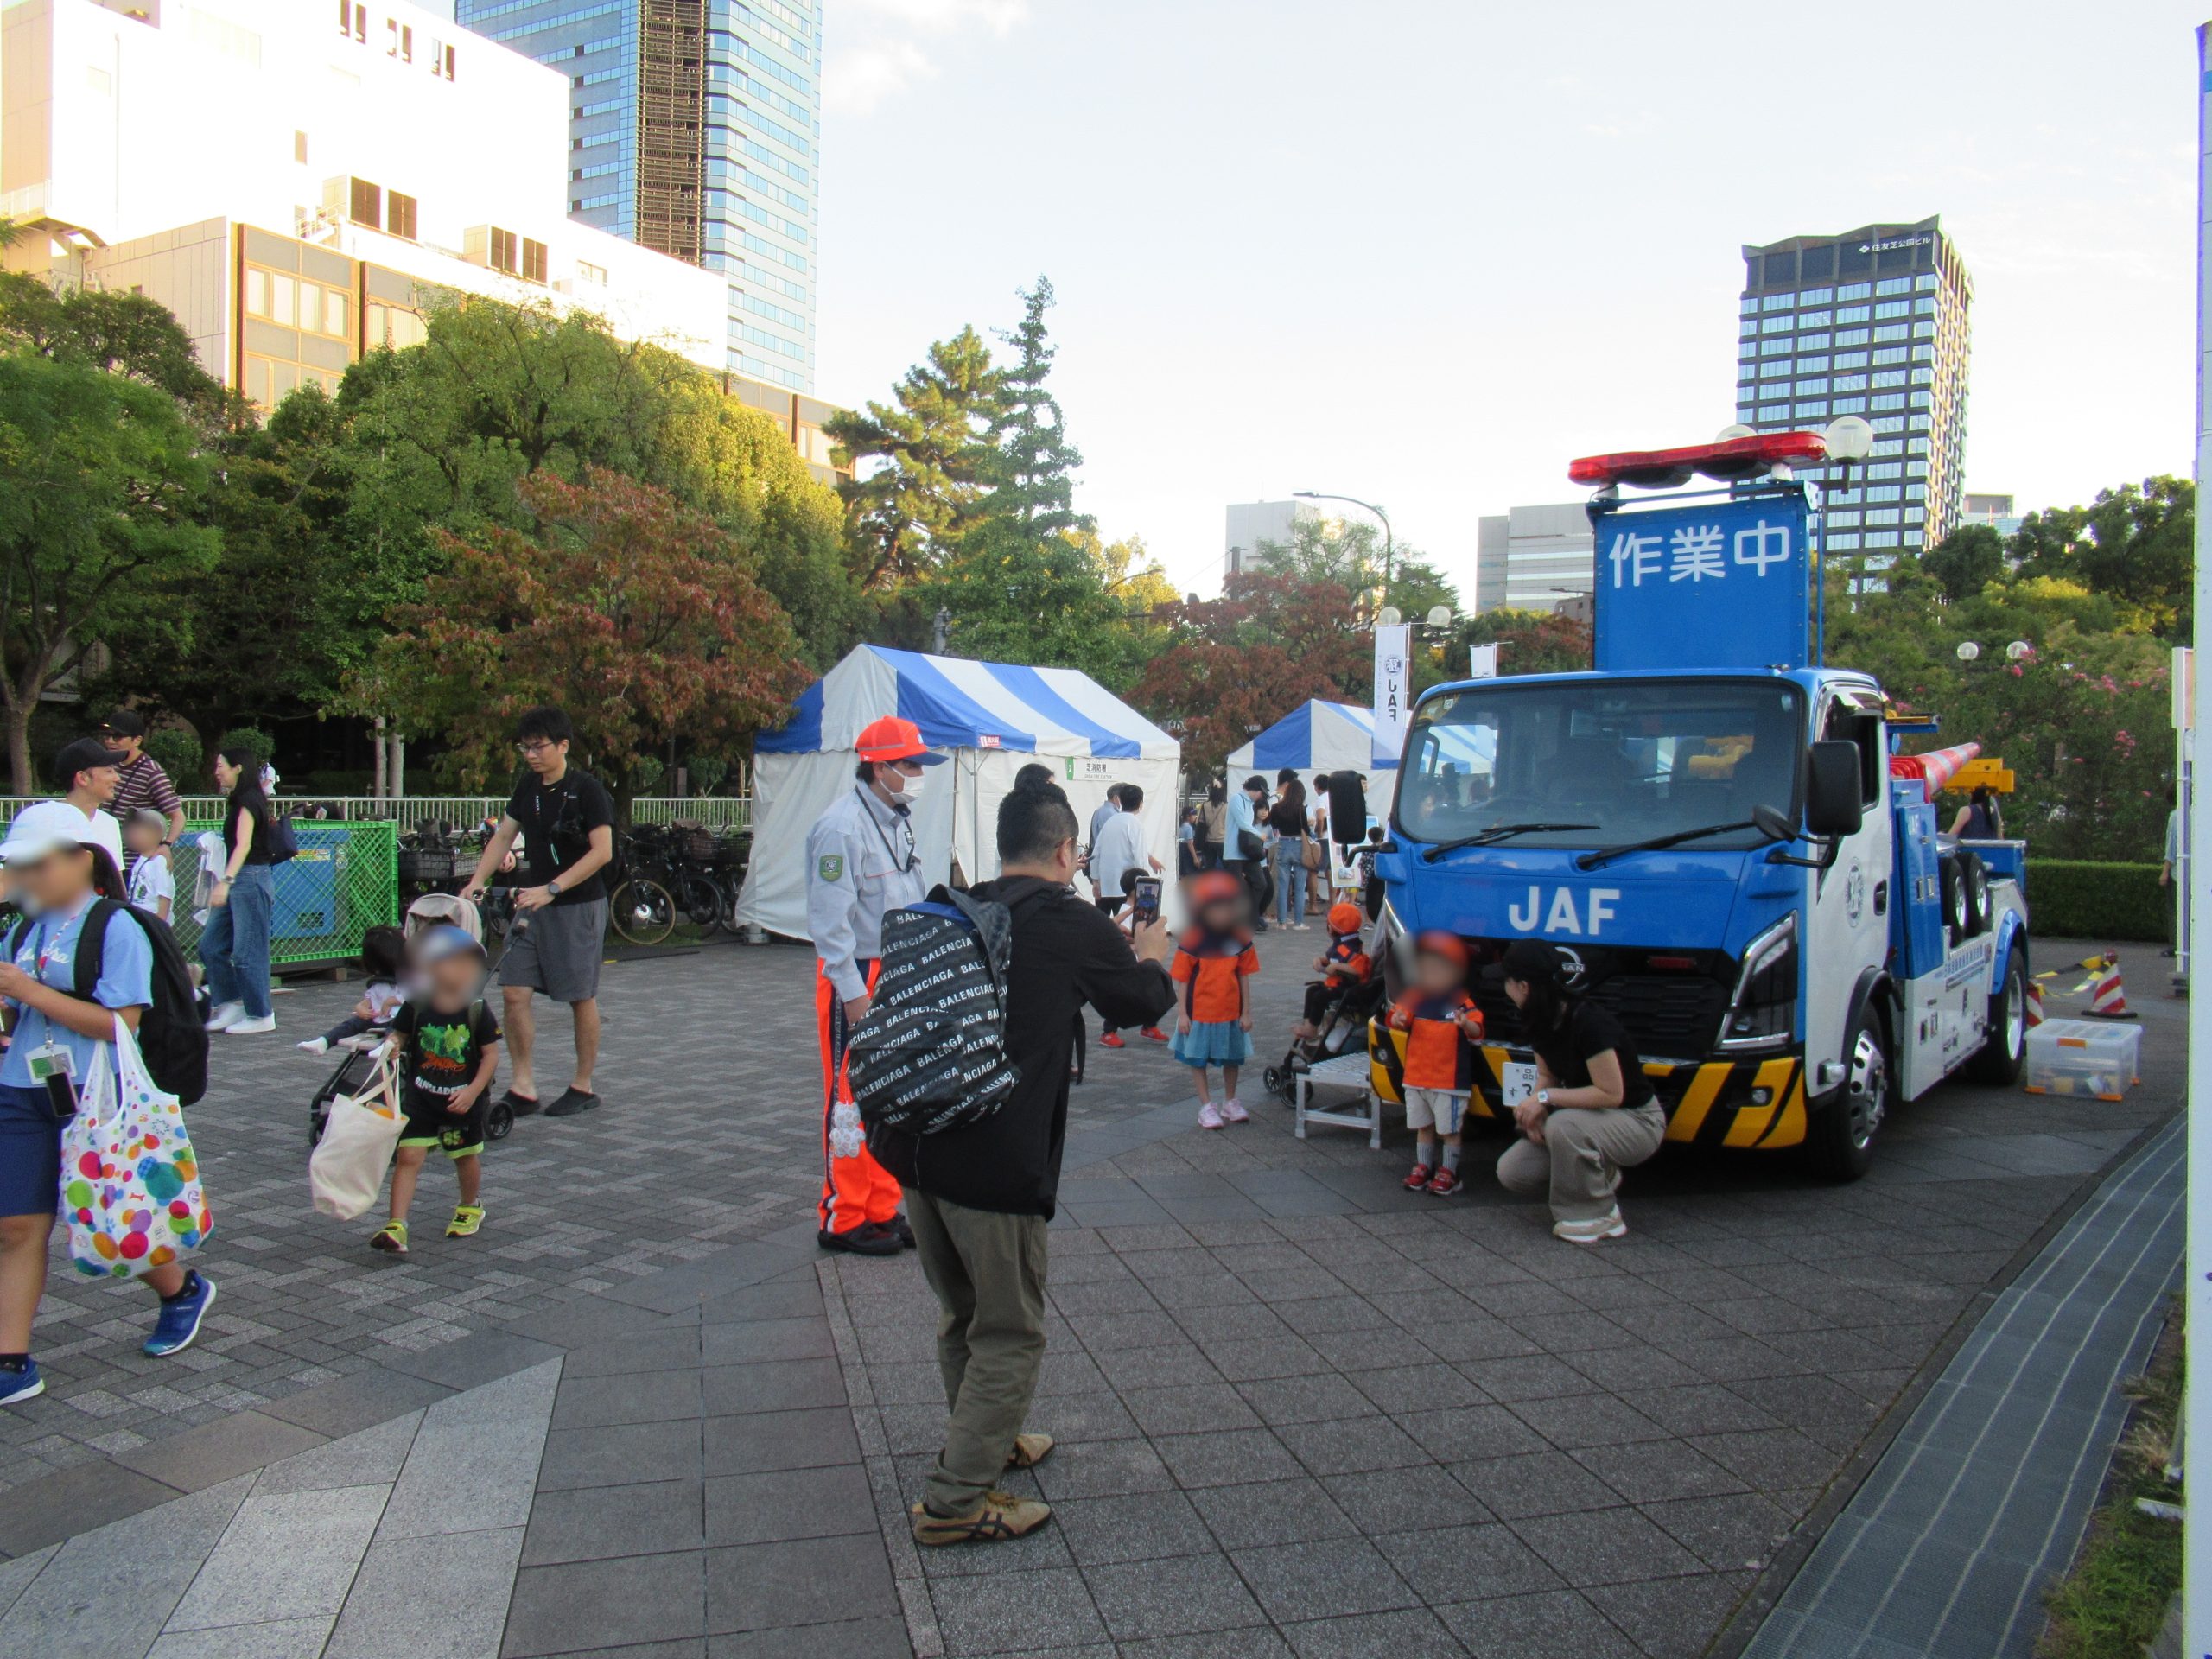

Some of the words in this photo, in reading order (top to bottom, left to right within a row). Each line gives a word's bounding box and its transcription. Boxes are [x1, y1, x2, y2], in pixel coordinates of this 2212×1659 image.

[1609, 519, 1790, 588] 作業中
[1508, 886, 1621, 936] JAF
[890, 969, 955, 1006] BALENCIAGA
[856, 1065, 912, 1101] BALENCIAGA
